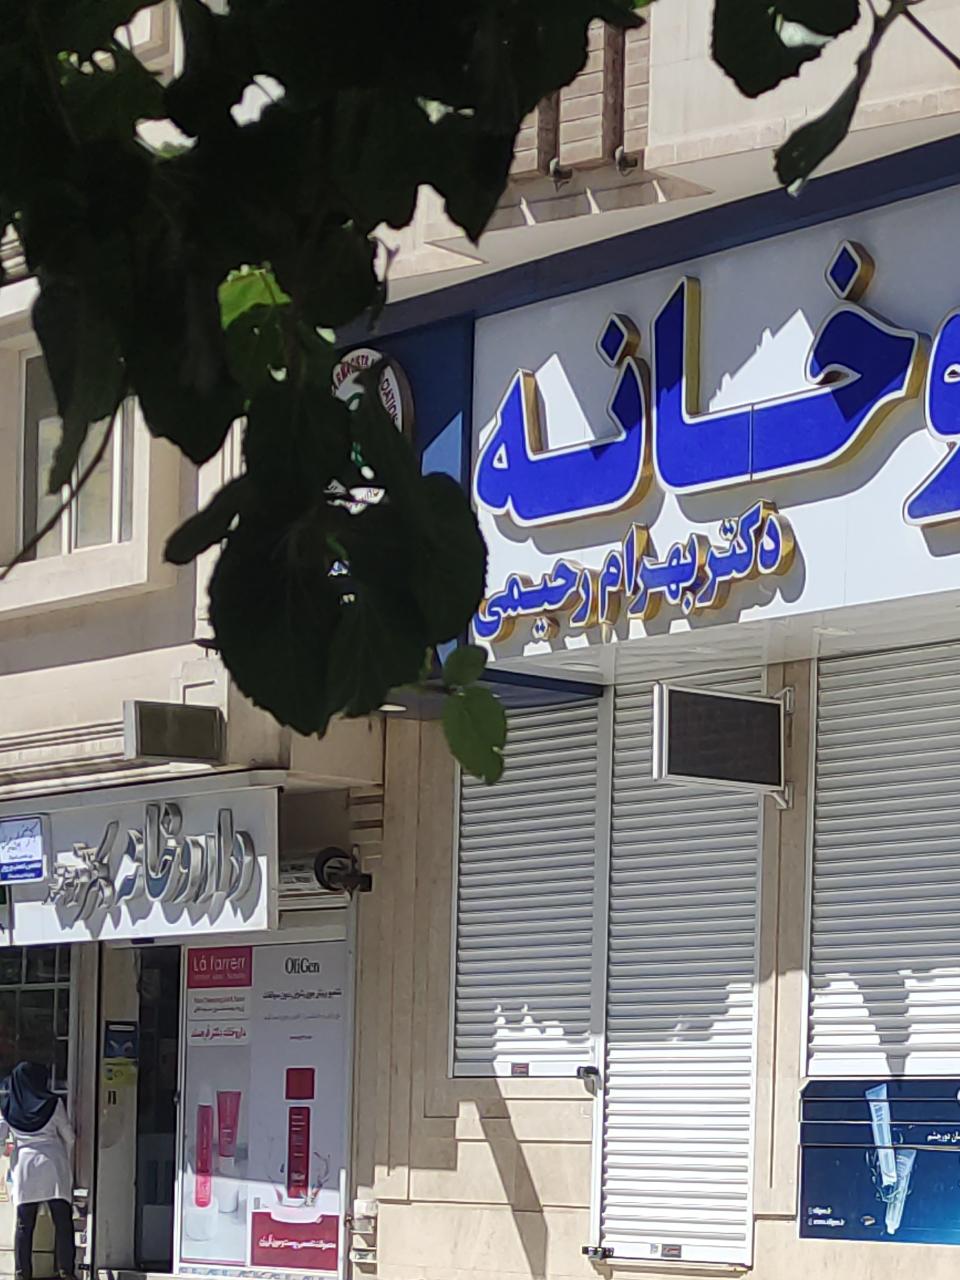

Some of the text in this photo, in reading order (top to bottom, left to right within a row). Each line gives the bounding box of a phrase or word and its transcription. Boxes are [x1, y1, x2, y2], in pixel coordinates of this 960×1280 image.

[472, 498, 788, 640] دکتر بهرام رحیمی
[285, 957, 320, 974] OliGen
